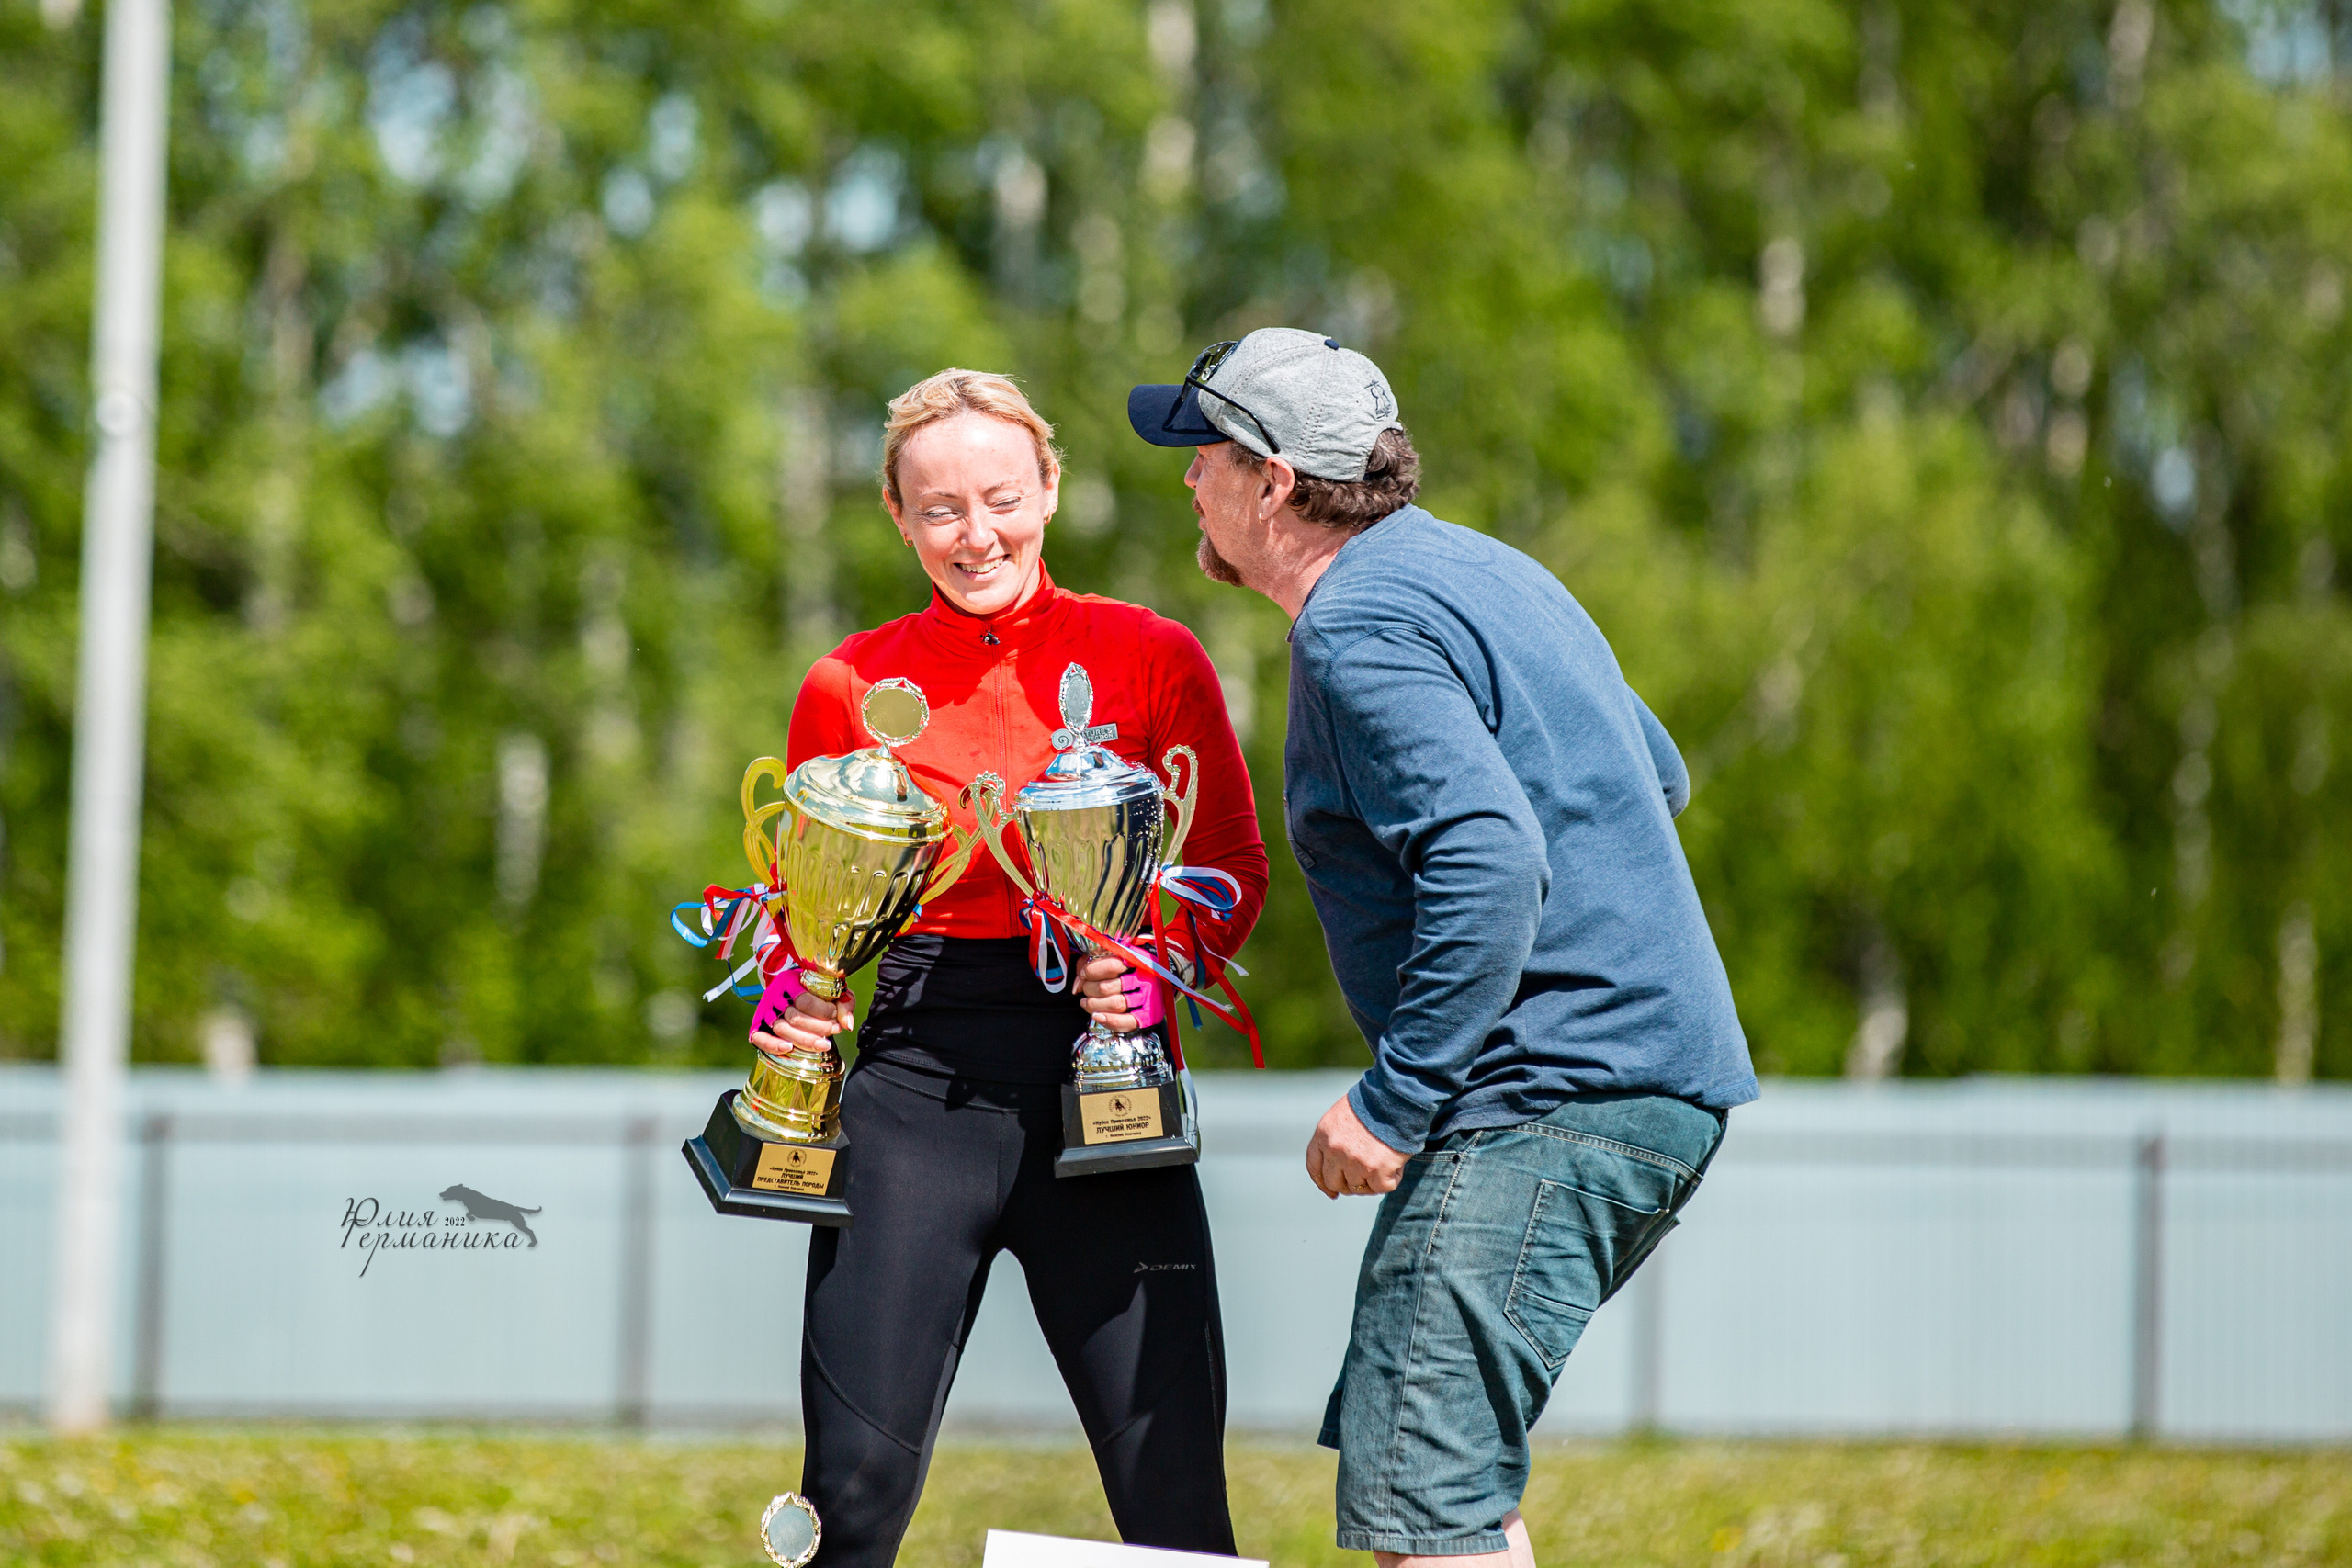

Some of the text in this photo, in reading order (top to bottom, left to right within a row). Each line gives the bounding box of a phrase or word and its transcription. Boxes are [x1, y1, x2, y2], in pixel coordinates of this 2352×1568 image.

[1096, 1122, 1150, 1134] ЛУЧШИЙ ЮНИОР
[757, 1177, 801, 1186] ПРЕДСТАВИТЕЛЬ
